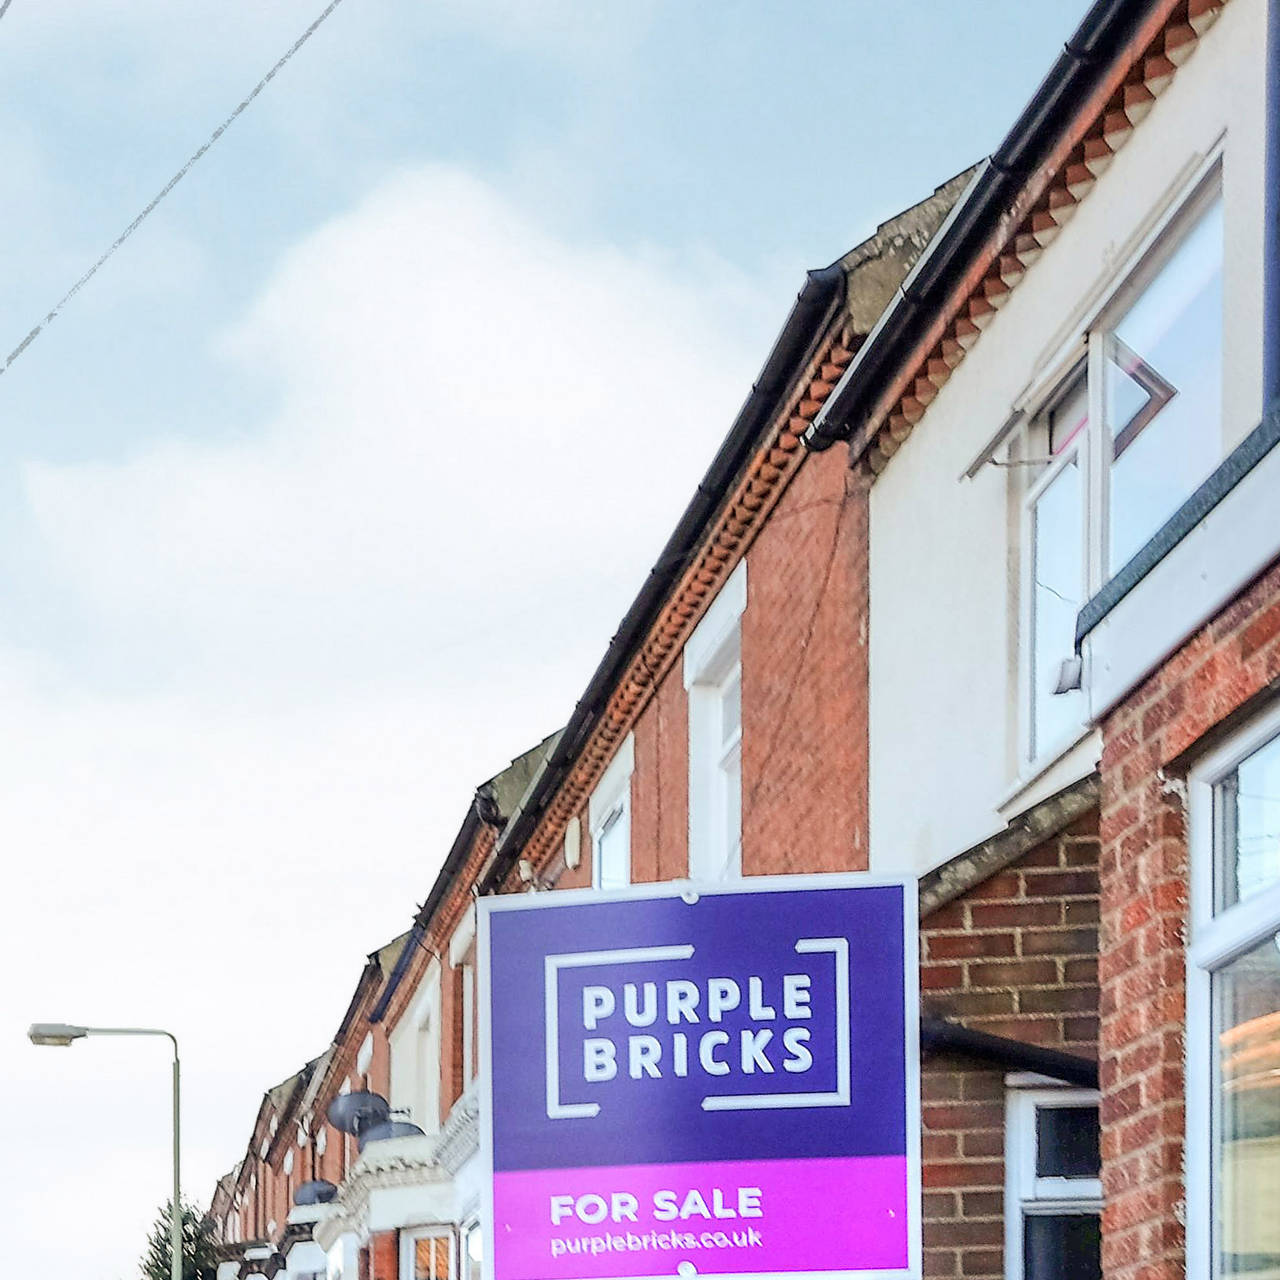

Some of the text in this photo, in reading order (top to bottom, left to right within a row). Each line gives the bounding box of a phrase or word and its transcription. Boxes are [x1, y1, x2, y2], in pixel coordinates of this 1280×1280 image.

[583, 974, 812, 1031] PURPLE
[583, 1026, 814, 1082] BRICKS
[550, 1187, 764, 1226] FOR SALE
[550, 1226, 763, 1258] purplebricks.co.uk
